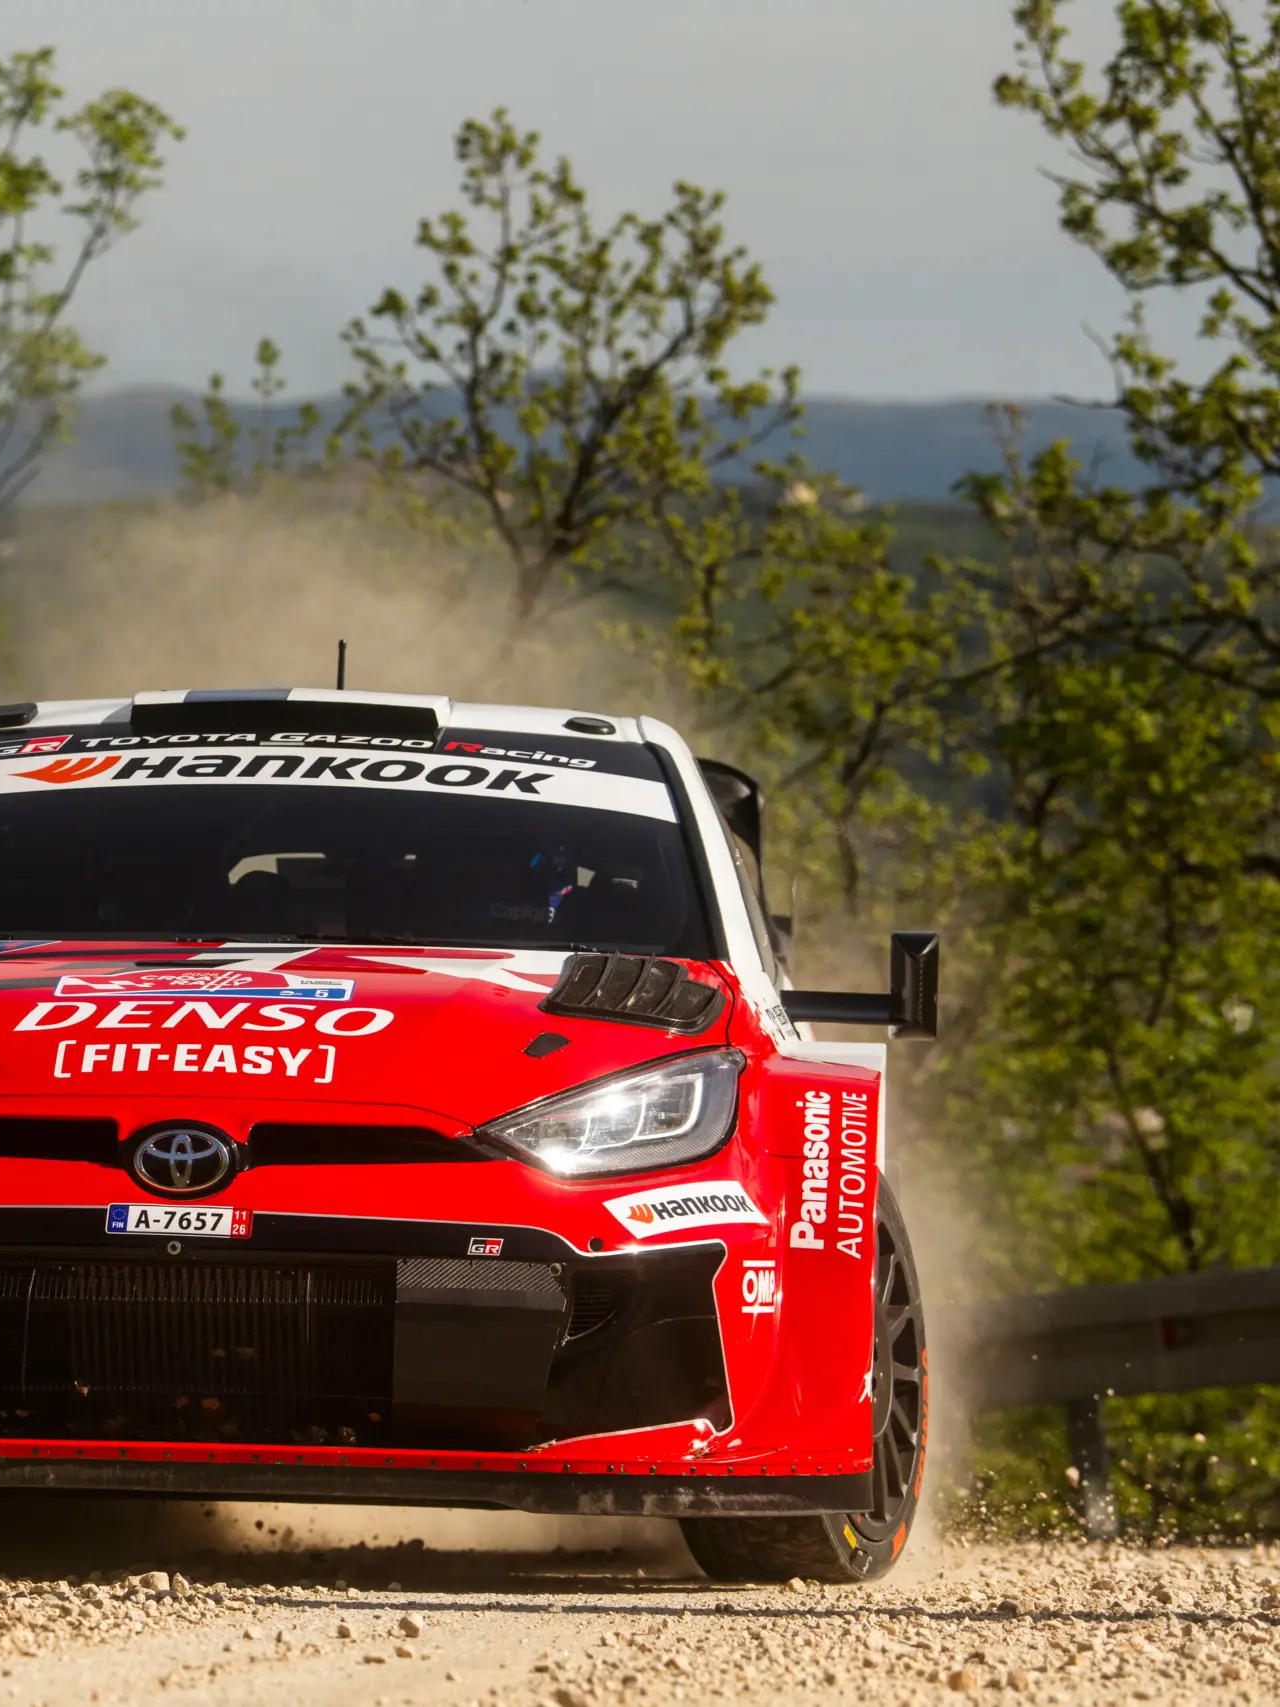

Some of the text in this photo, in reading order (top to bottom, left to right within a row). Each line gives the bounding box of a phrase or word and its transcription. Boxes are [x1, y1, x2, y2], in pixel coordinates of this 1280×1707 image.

[80, 733, 257, 748] TOYOTA
[269, 732, 434, 749] GAZOO
[443, 741, 597, 768] Racing
[314, 989, 329, 998] 5
[13, 1001, 395, 1036] DENSO
[789, 1090, 832, 1250] Panasonic
[836, 1091, 868, 1260] AUTOMOTIVE
[134, 1209, 224, 1231] A-7657
[234, 1211, 246, 1220] 11
[232, 1225, 246, 1235] 26
[471, 1244, 500, 1254] GR
[742, 1269, 776, 1304] OMP
